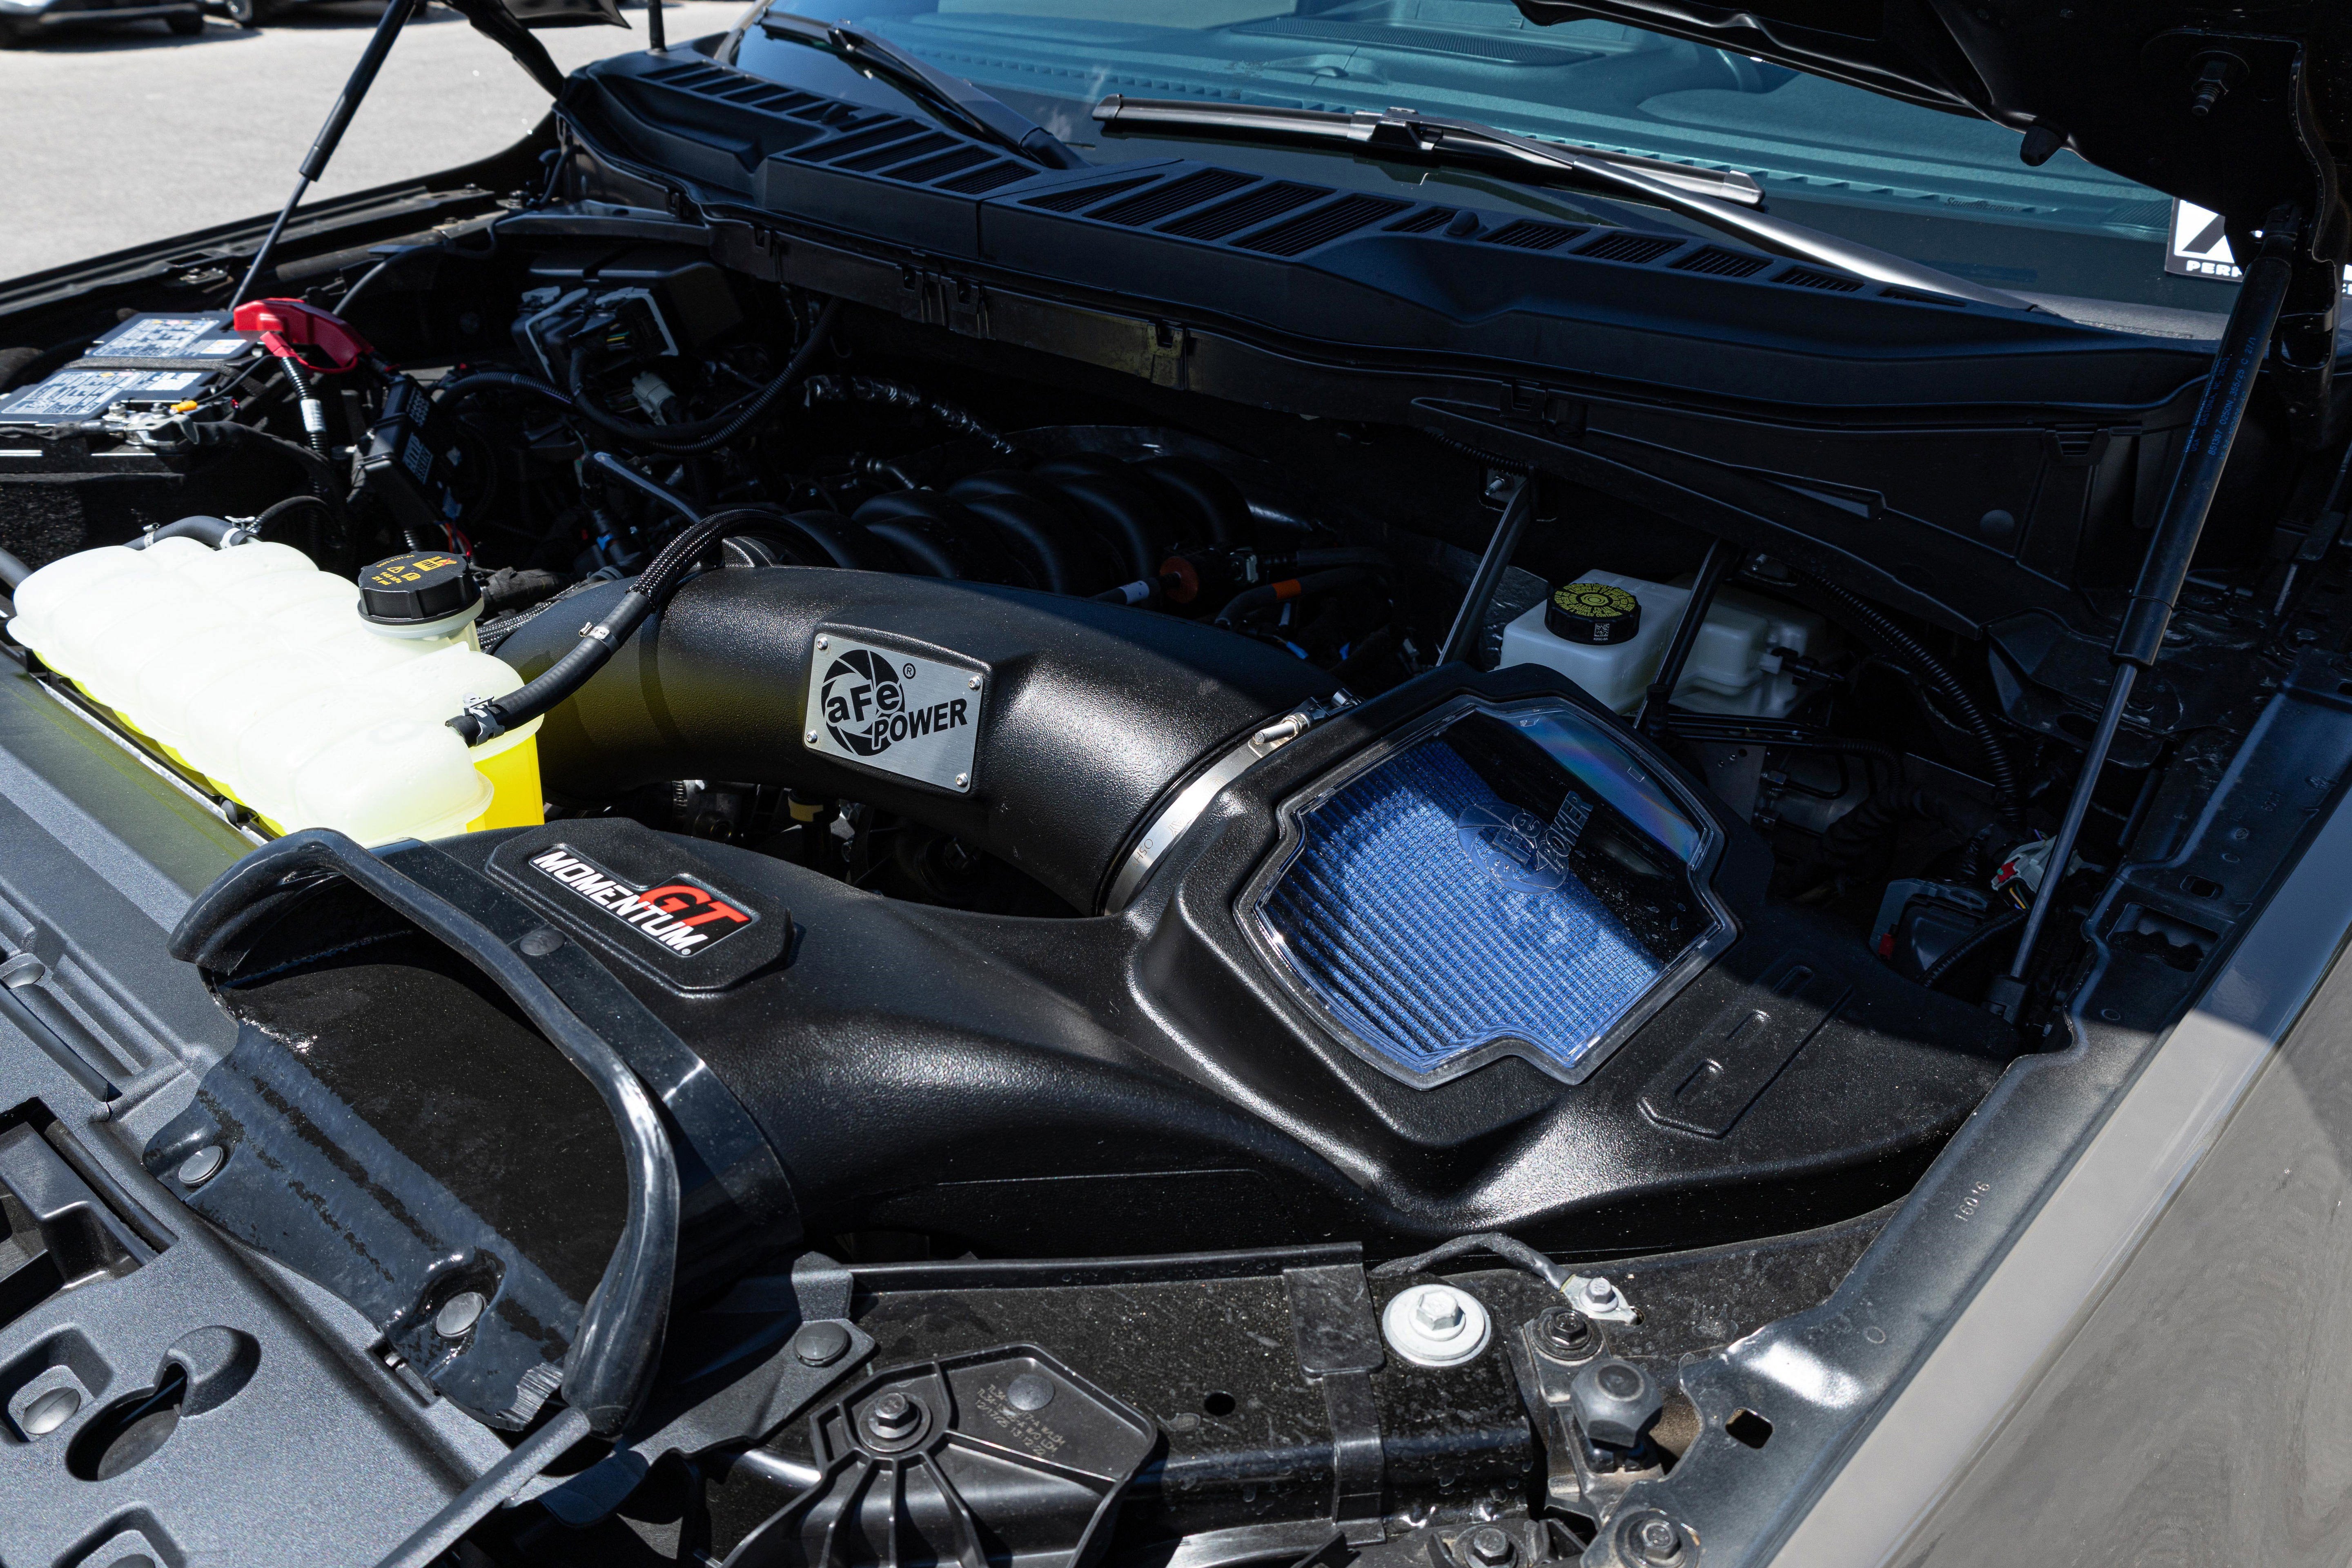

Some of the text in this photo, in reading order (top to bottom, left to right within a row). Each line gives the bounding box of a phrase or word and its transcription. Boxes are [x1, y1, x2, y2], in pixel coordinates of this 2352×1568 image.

[827, 684, 900, 724] aFe
[873, 698, 968, 748] POWER
[533, 851, 708, 951] MOMENTUM
[637, 885, 750, 927] GT
